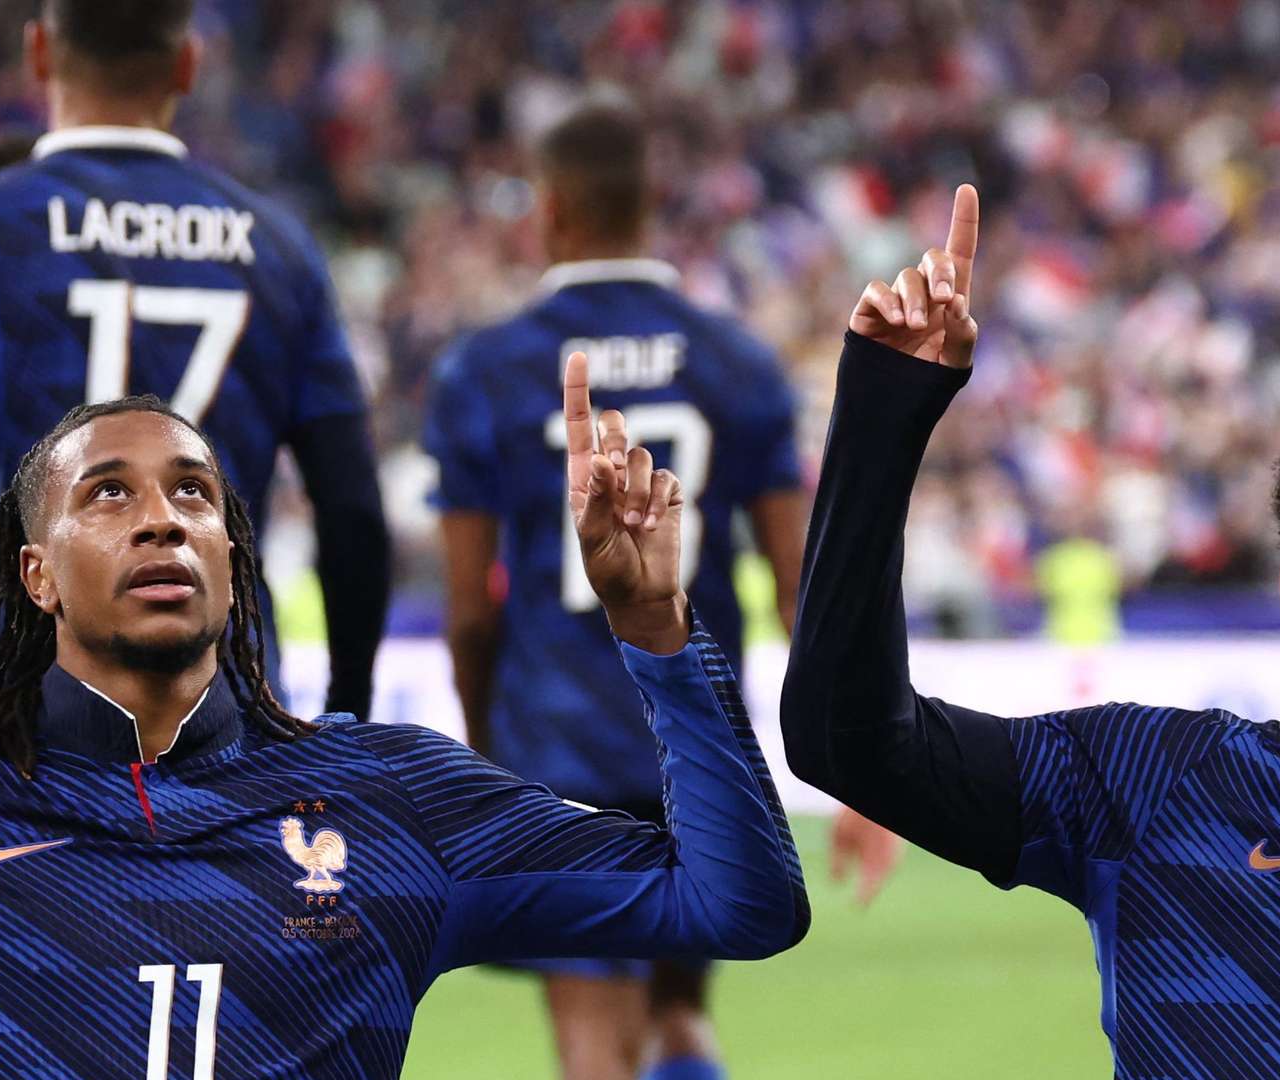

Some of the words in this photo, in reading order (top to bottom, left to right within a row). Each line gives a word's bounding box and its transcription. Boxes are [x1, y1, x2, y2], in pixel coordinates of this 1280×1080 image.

[48, 196, 256, 265] LACROIX
[67, 279, 251, 428] 17
[282, 927, 296, 938] 05
[283, 915, 316, 928] FRANCE
